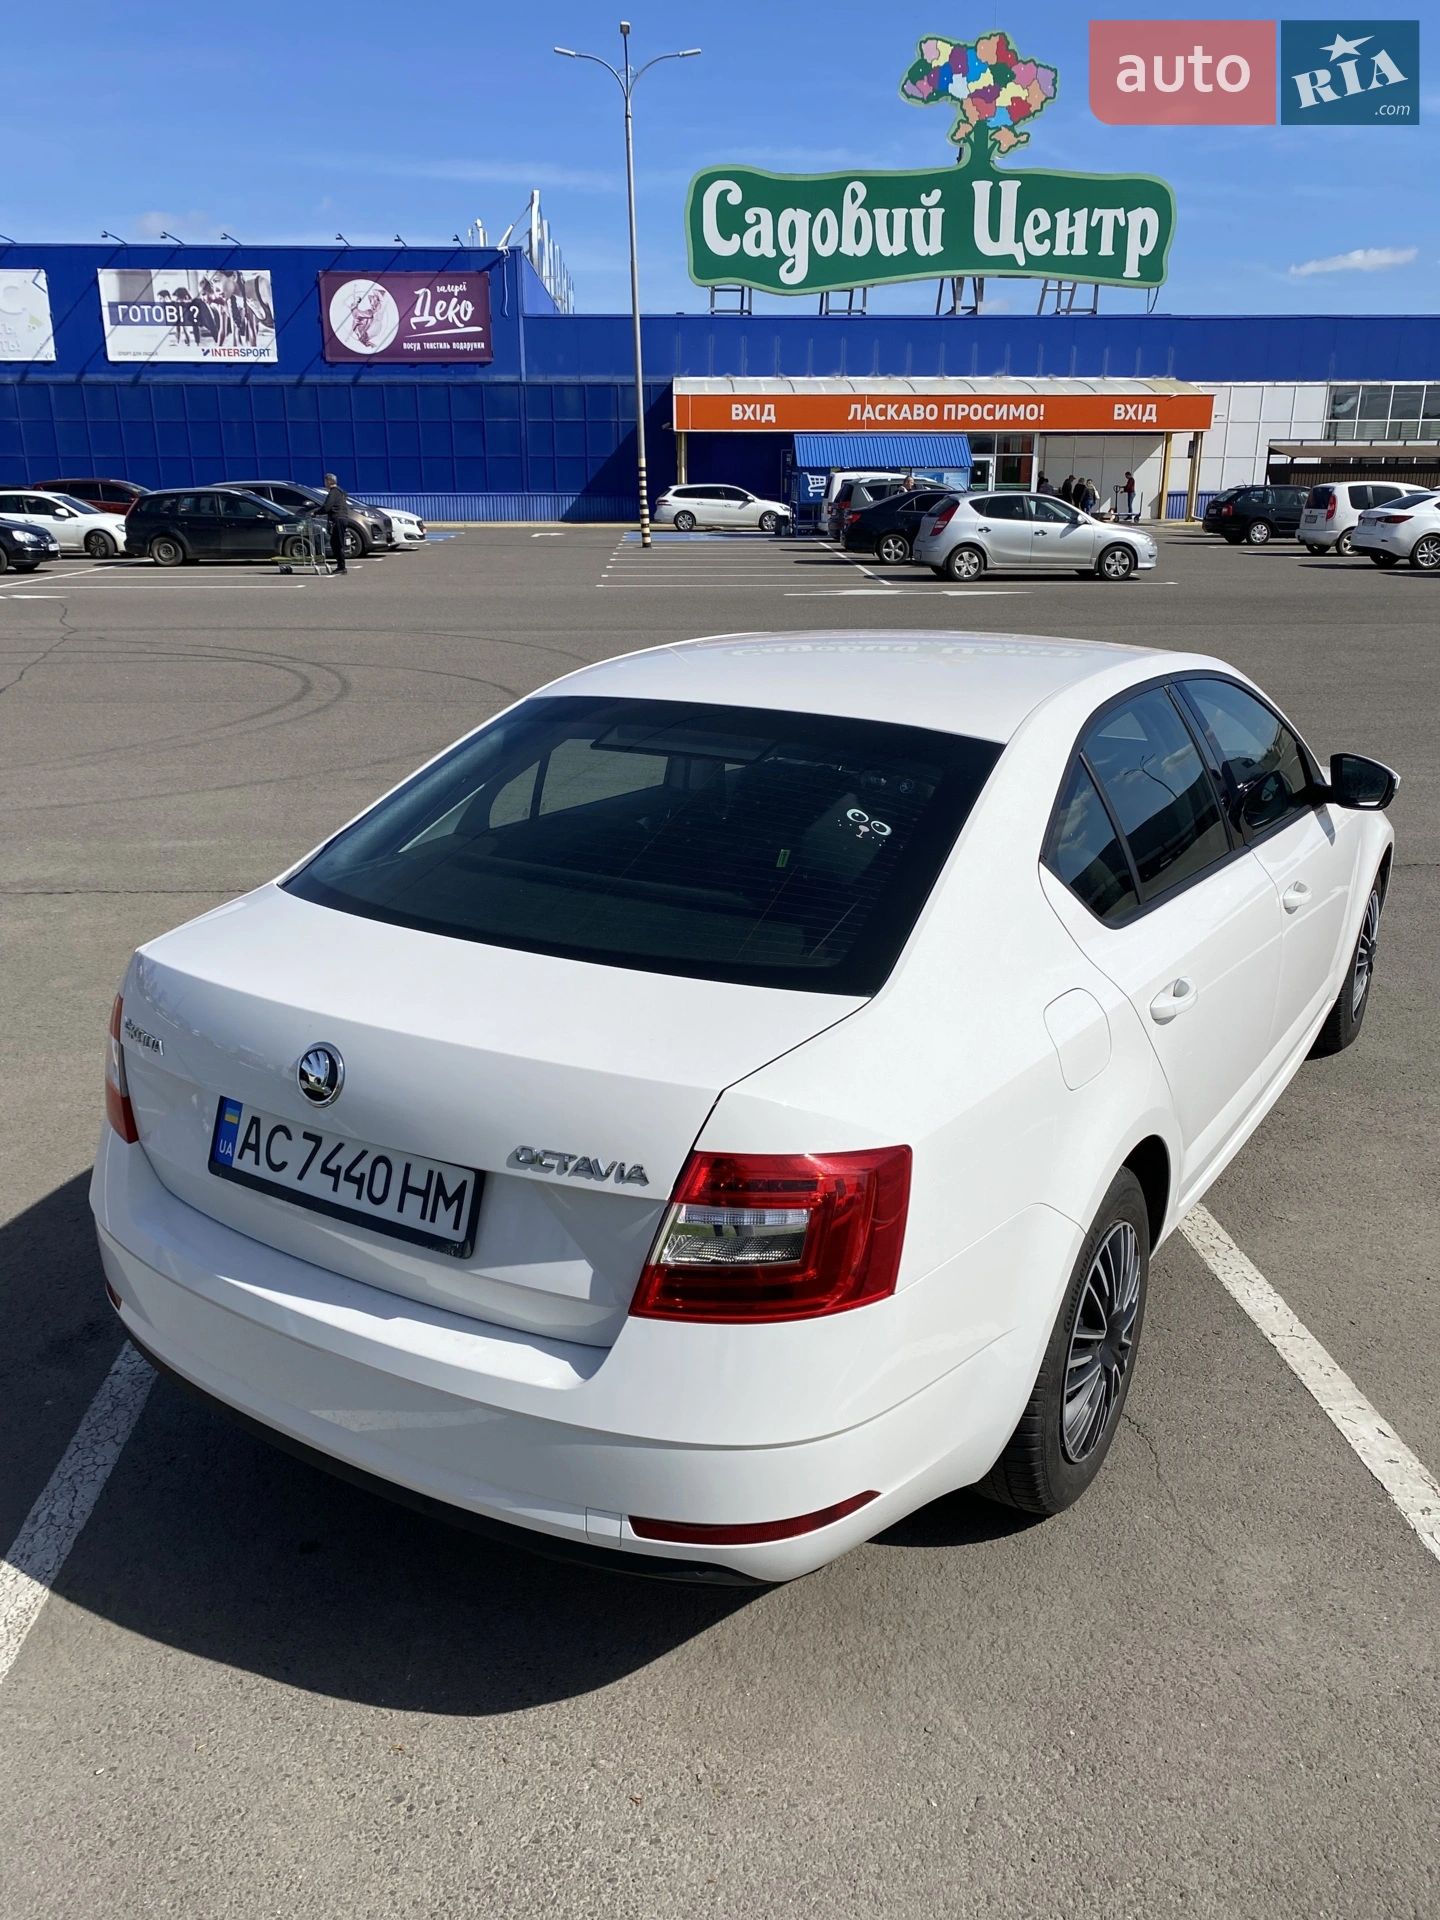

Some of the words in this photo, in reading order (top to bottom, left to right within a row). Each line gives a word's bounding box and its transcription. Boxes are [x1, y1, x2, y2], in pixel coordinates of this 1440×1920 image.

[702, 179, 945, 285] Садовий
[971, 179, 1160, 279] Центр
[436, 282, 467, 296] галереї
[117, 304, 184, 323] ГОТОВІ
[410, 288, 475, 330] Деко
[211, 348, 271, 357] INTERSPORT
[403, 342, 421, 351] посуд
[423, 341, 451, 350] текстиль
[452, 341, 485, 351] подарунки
[731, 403, 776, 423] ВХІД
[847, 404, 939, 421] ЛАСКАВО
[943, 404, 1045, 421] ПРОСИМО!
[1113, 403, 1157, 423] ВХІД
[219, 1139, 233, 1157] UA
[515, 1145, 650, 1185] OCTAVIA
